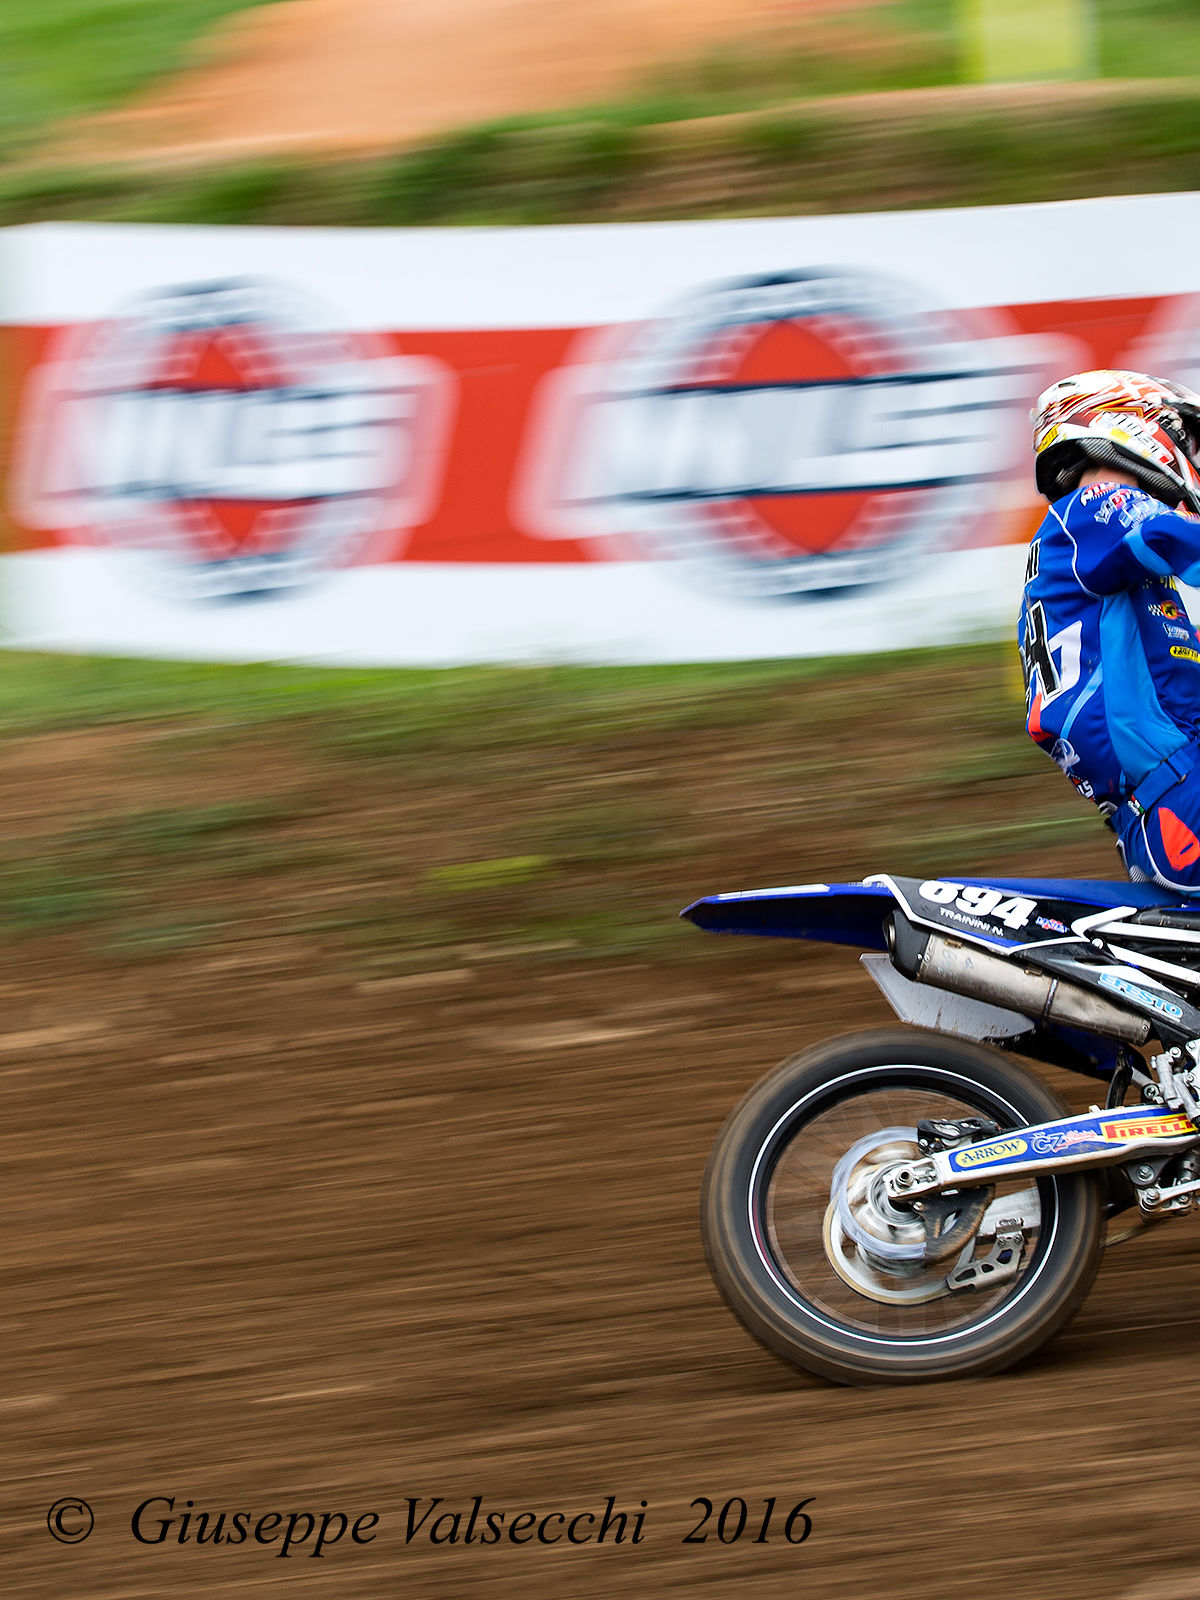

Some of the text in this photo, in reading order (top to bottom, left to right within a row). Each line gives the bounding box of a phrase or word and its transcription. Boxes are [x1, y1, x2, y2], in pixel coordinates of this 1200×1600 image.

[919, 880, 1038, 930] 694
[1099, 973, 1183, 1019] EFESTO
[1105, 1115, 1194, 1139] PIRELLI
[963, 1141, 1020, 1163] ARROW
